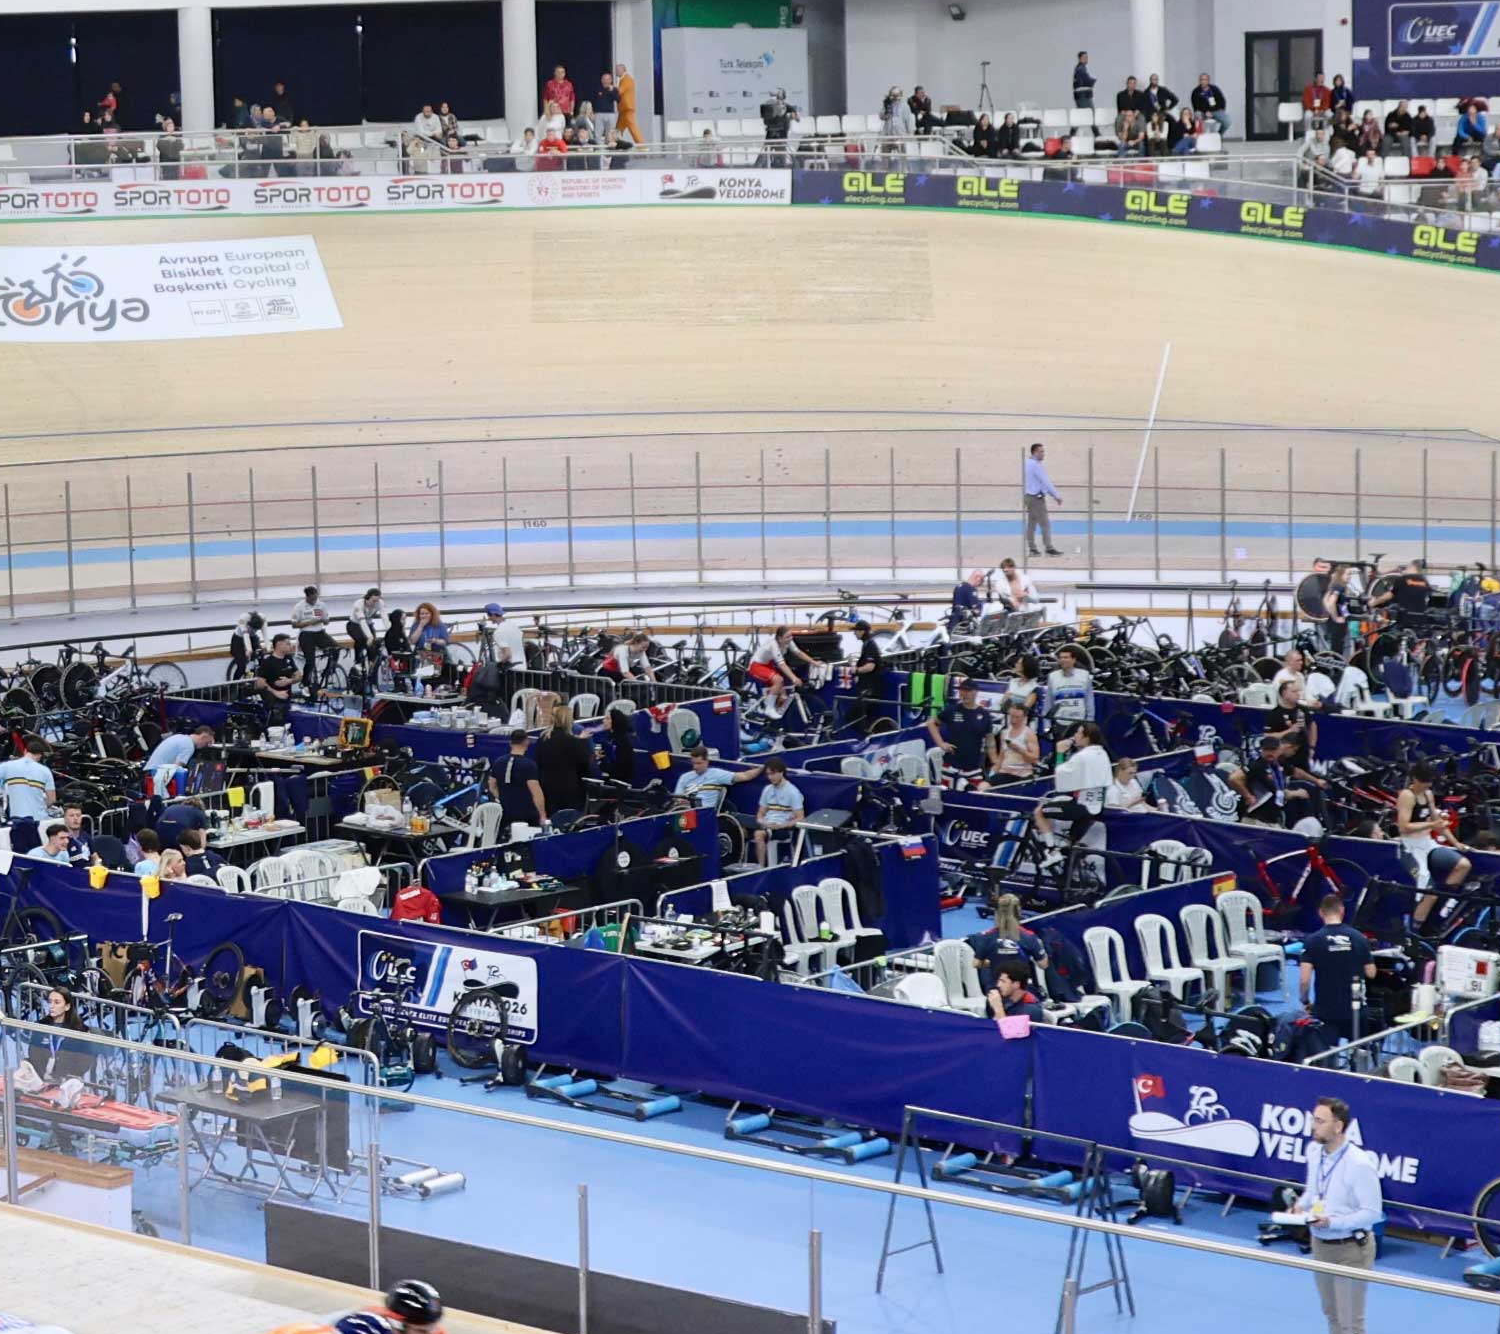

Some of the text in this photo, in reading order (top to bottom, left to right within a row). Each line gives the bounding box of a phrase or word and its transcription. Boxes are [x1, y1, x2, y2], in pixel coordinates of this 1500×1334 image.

[1424, 24, 1459, 37] UEC
[719, 177, 762, 188] KONYA
[718, 189, 785, 200] VELODROME
[158, 247, 306, 268] Avrupa European
[161, 261, 311, 280] Bisiklet Capital of
[153, 275, 297, 295] Başkenti Cycling
[961, 829, 991, 844] UEC
